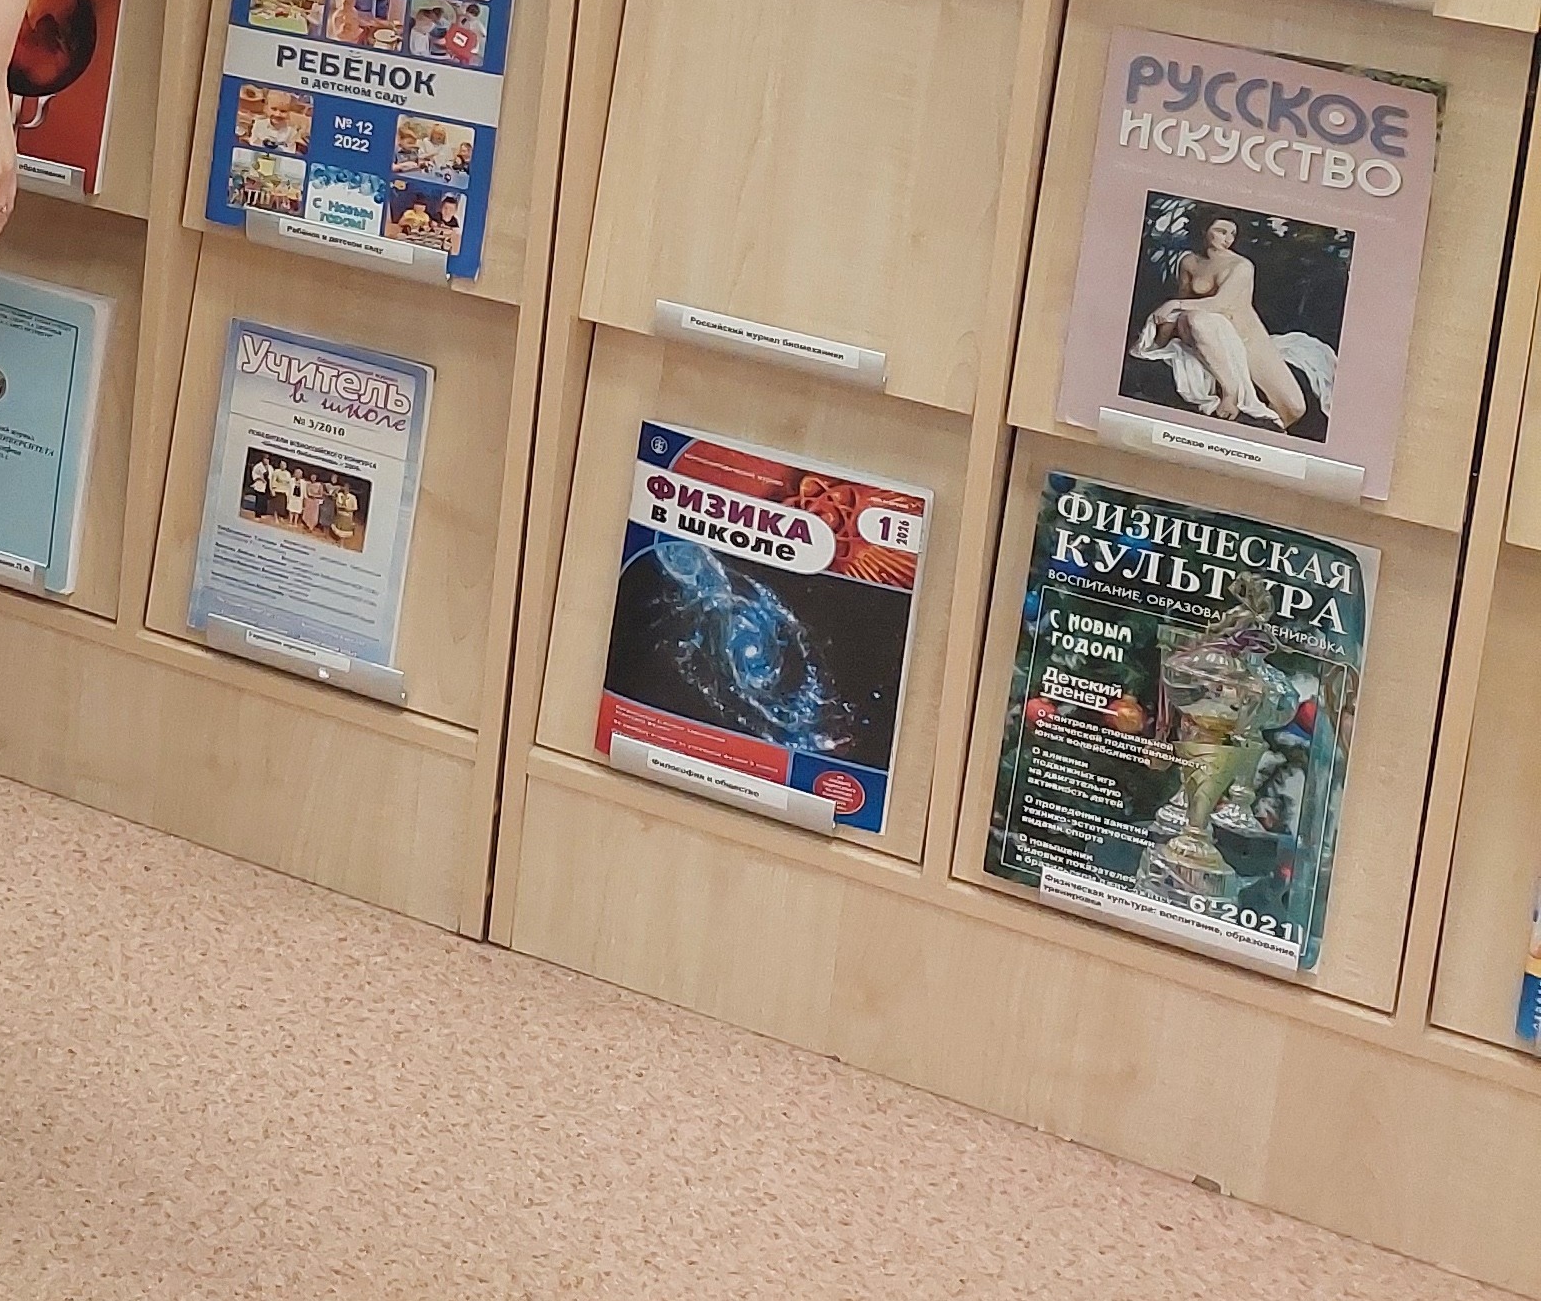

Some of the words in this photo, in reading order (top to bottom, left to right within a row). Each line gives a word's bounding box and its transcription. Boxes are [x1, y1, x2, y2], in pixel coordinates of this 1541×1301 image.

[312, 78, 371, 97] детском
[375, 90, 407, 106] саду
[1125, 55, 1409, 158] РУССКОЕ
[333, 135, 370, 152] 2022
[355, 120, 374, 135] 12
[1119, 109, 1403, 198] ИСКУССТВО
[690, 316, 744, 335] Российский
[746, 331, 780, 345] журнал
[242, 334, 411, 415] Учитель
[321, 398, 406, 431] школе
[1163, 432, 1205, 448] Русское
[1208, 445, 1261, 462] искусство
[646, 475, 813, 546] ФИЗИКА
[879, 517, 891, 541] 1
[650, 504, 668, 523] в
[677, 513, 796, 562] школе
[1058, 492, 1353, 595] ФИЗИЧЕСКАЯ
[1048, 568, 1143, 604] ВОСПИТАНИЕ,
[1051, 528, 1348, 635] КУЛЬТРА
[1050, 610, 1061, 629] С
[1042, 666, 1122, 698] Детский
[1035, 728, 1064, 742] юных
[1067, 738, 1151, 765] волейболистов
[1038, 709, 1045, 717] О
[1101, 728, 1173, 751] специальной
[1032, 747, 1040, 755] О
[1105, 737, 1206, 770] подготовленности
[651, 758, 705, 780] Философия
[715, 780, 759, 797] общество
[1029, 766, 1042, 775] на
[1044, 772, 1121, 797] двигательную
[1033, 758, 1095, 781] подвижных
[1097, 775, 1116, 786] игр
[1028, 777, 1089, 799] активность
[1090, 795, 1124, 809] детей
[1022, 816, 1062, 832] видами
[1065, 828, 1104, 844] спорта
[1024, 794, 1032, 803] О
[1035, 798, 1102, 823] проведении
[1104, 818, 1148, 836] занятий
[1017, 844, 1064, 863] силовых
[1066, 857, 1136, 883] показателей
[1019, 833, 1027, 842] О
[1029, 837, 1093, 861] повышении
[1045, 874, 1105, 898] Физическая
[1107, 892, 1156, 913] культура:
[1159, 910, 1222, 936] воспитание,
[1226, 930, 1297, 958] образование,
